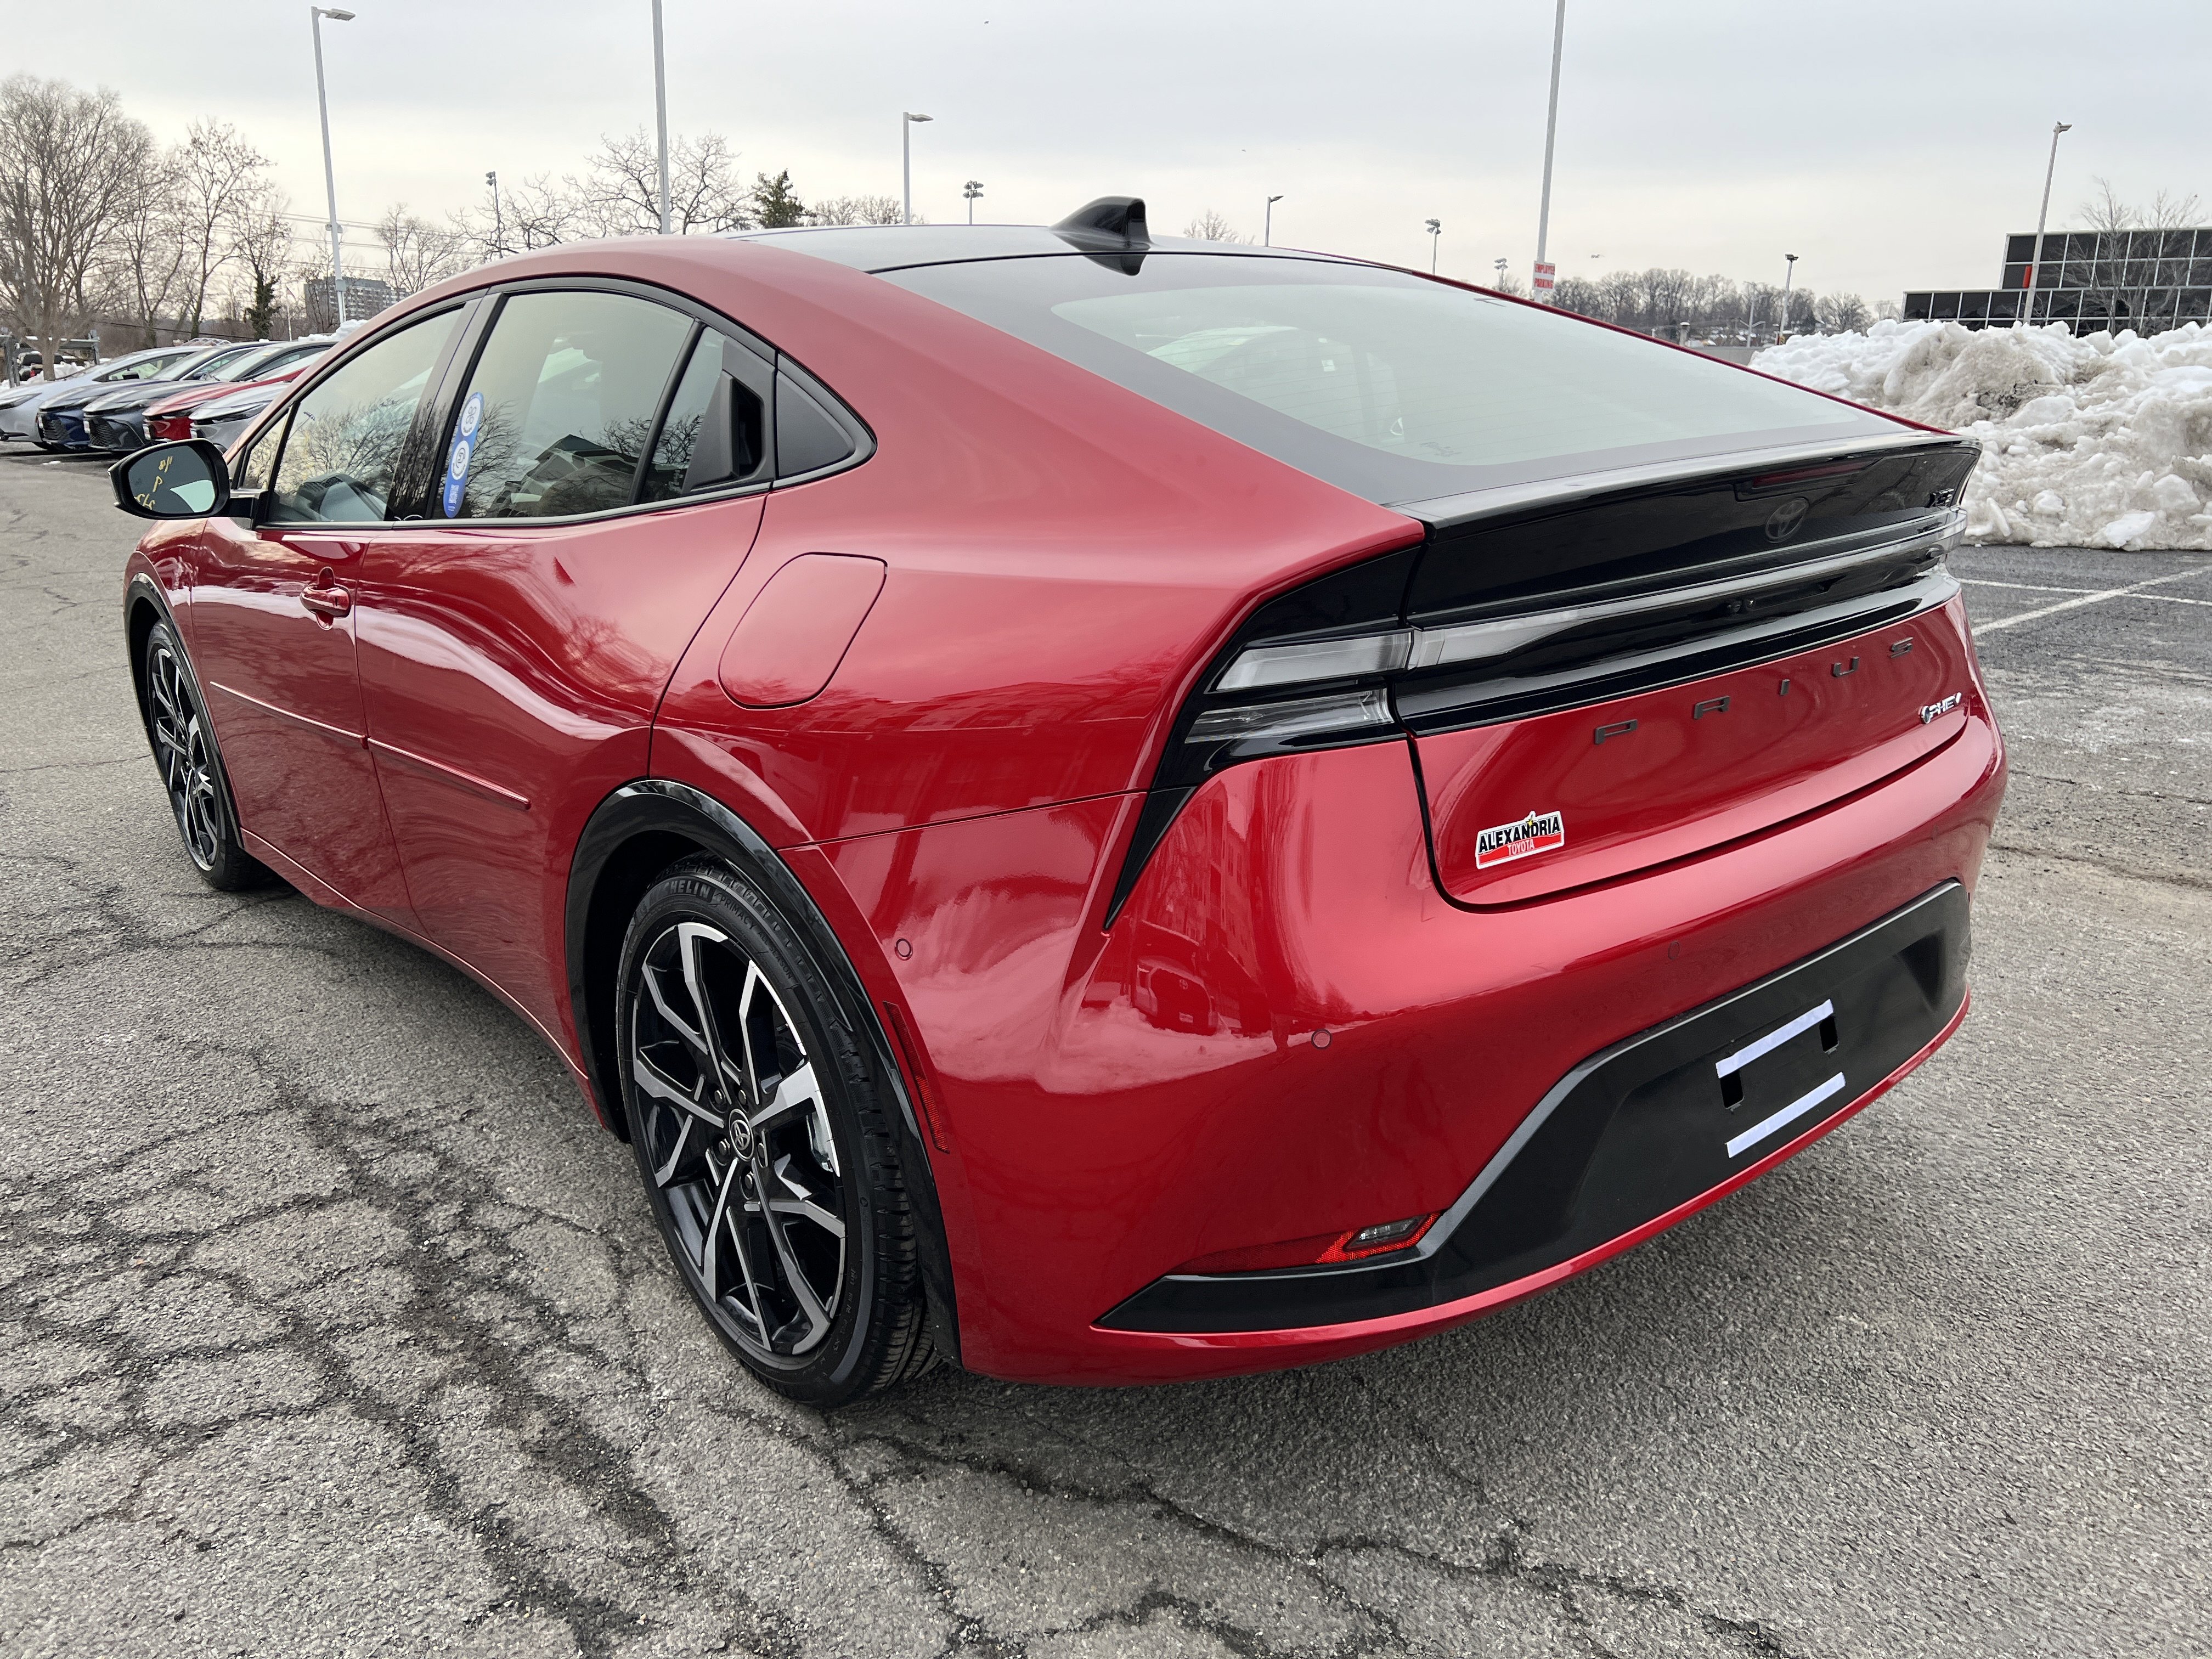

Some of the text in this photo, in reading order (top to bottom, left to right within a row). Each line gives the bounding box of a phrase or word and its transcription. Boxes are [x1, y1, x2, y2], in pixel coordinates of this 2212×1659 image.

[1595, 637, 1914, 744] PRIUS
[1480, 817, 1560, 853] ALEXANDRIA
[1508, 839, 1534, 855] TOYOTA
[652, 879, 793, 979] CHELIN PRIMACY ALL SEASON
